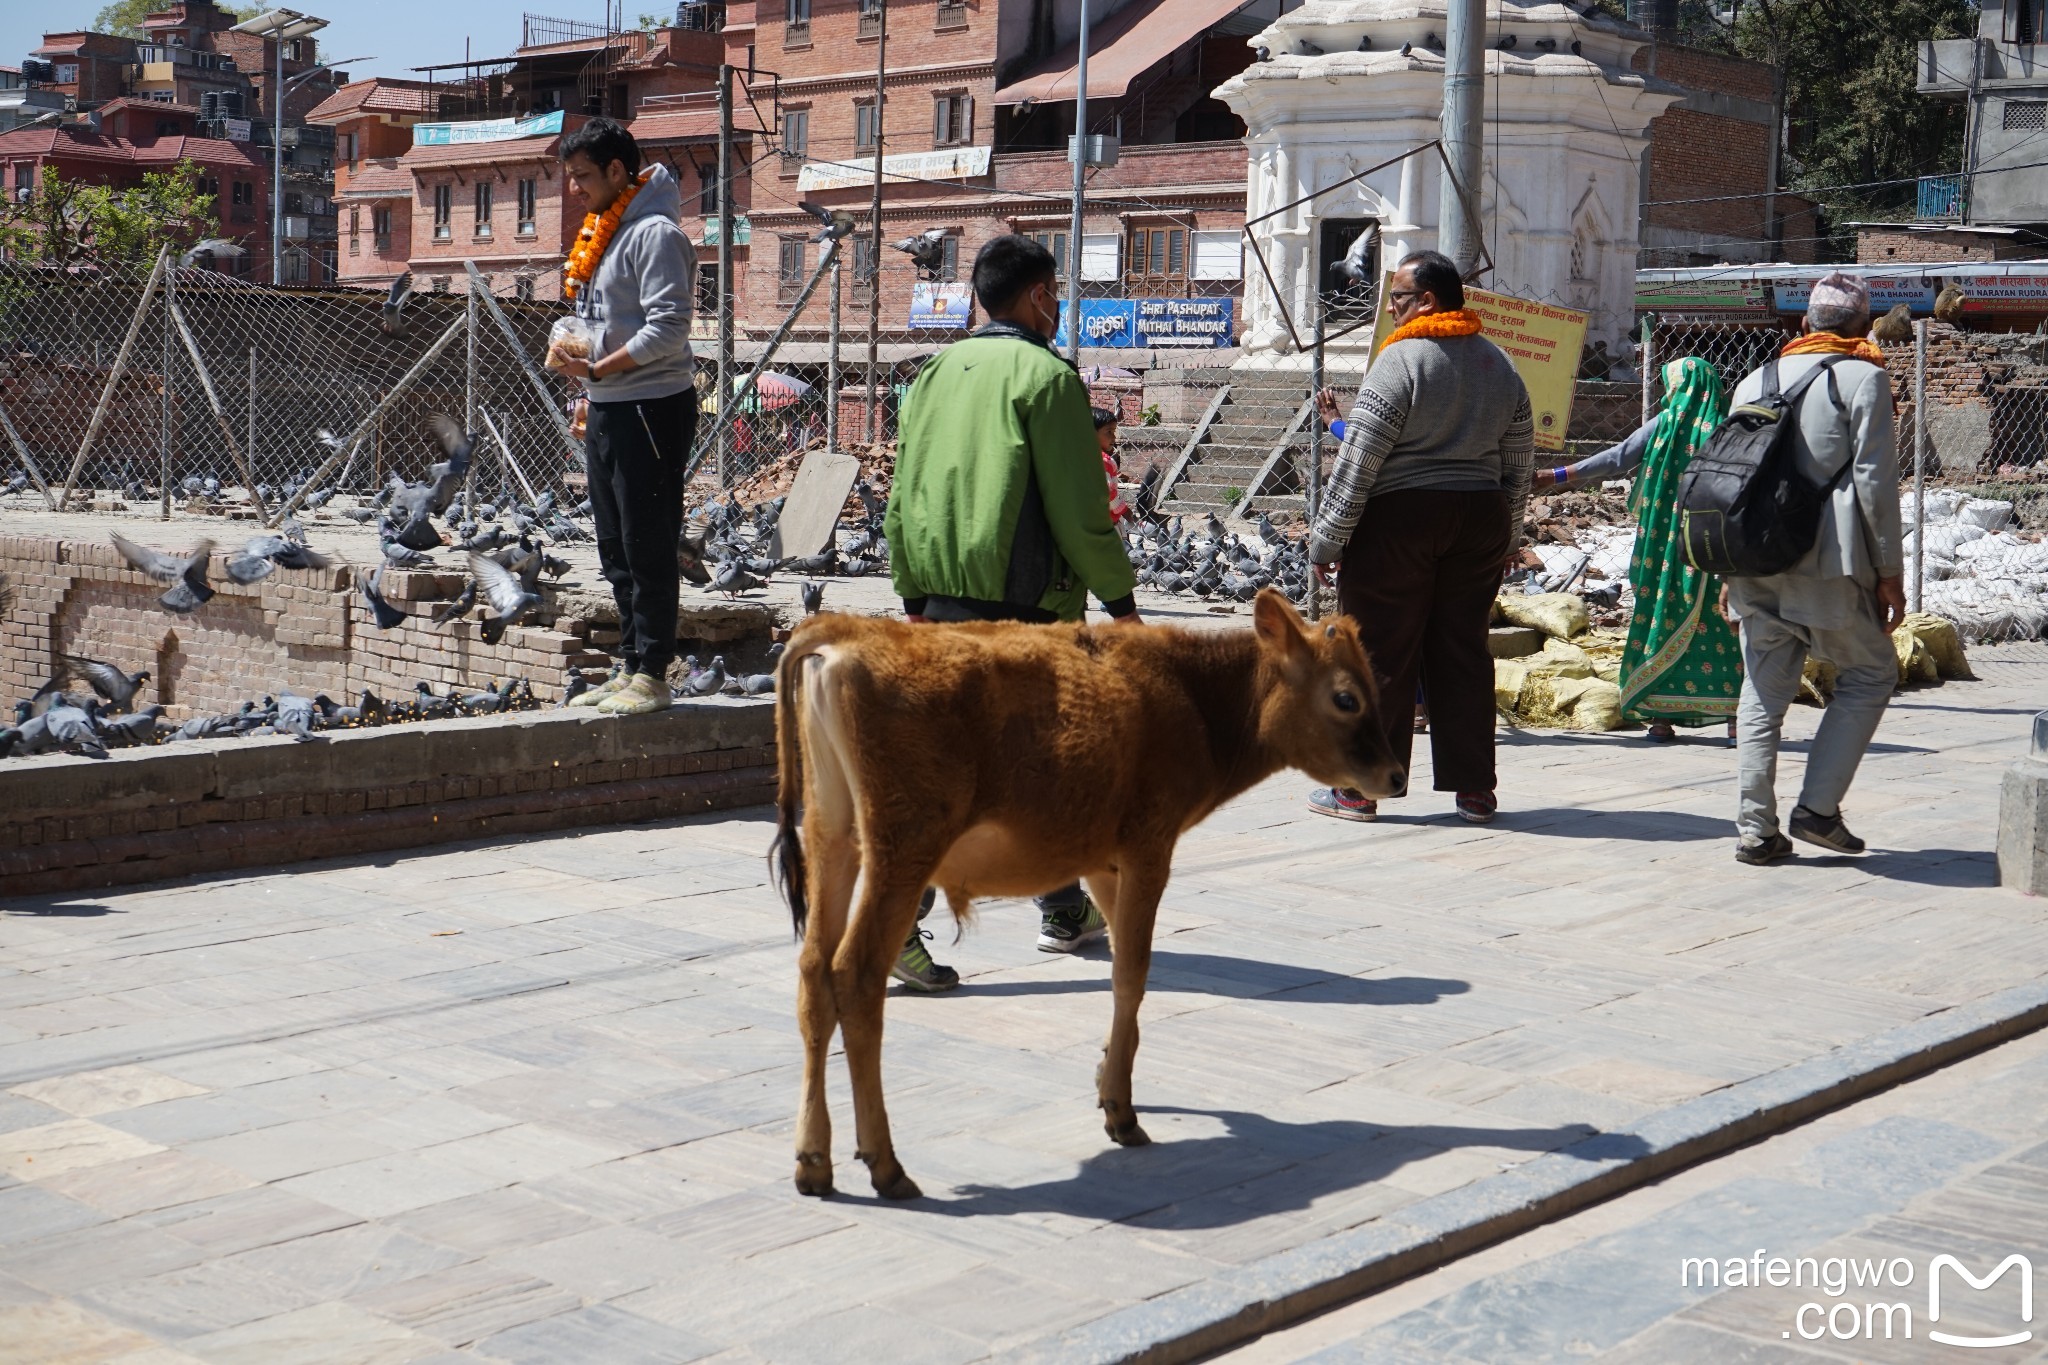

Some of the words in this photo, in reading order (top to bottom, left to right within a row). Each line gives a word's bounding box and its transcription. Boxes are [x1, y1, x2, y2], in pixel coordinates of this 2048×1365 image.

[926, 152, 971, 168] भण्डार
[925, 165, 969, 178] BHANDAR
[1977, 289, 2016, 297] NARAYAN
[1141, 301, 1164, 315] SHRI
[1498, 299, 1524, 311] पशुपति
[1541, 306, 1566, 321] विकास
[1567, 313, 1584, 324] कोष
[1138, 319, 1173, 333] MITHAI
[1176, 319, 1227, 333] BHANDAR
